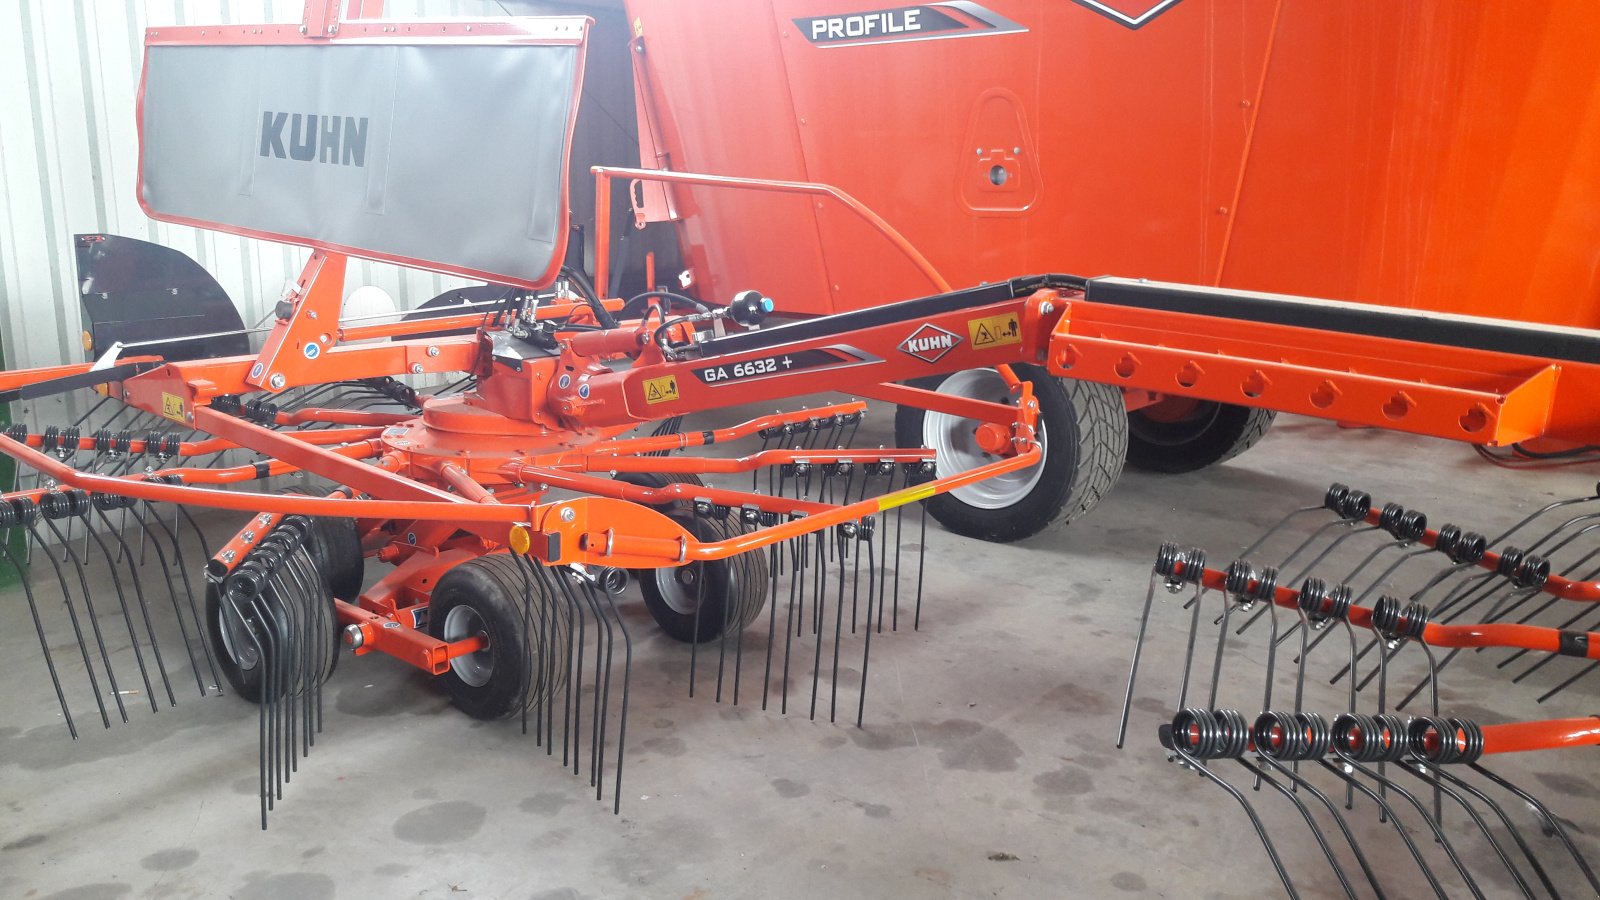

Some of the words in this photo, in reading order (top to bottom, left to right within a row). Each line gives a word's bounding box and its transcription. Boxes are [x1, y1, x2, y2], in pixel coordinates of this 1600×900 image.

[811, 9, 921, 40] PROFILE
[260, 110, 369, 168] KUHN
[907, 334, 953, 353] KUHN
[704, 367, 729, 382] GA
[733, 358, 777, 377] 6632
[782, 355, 793, 369] +
